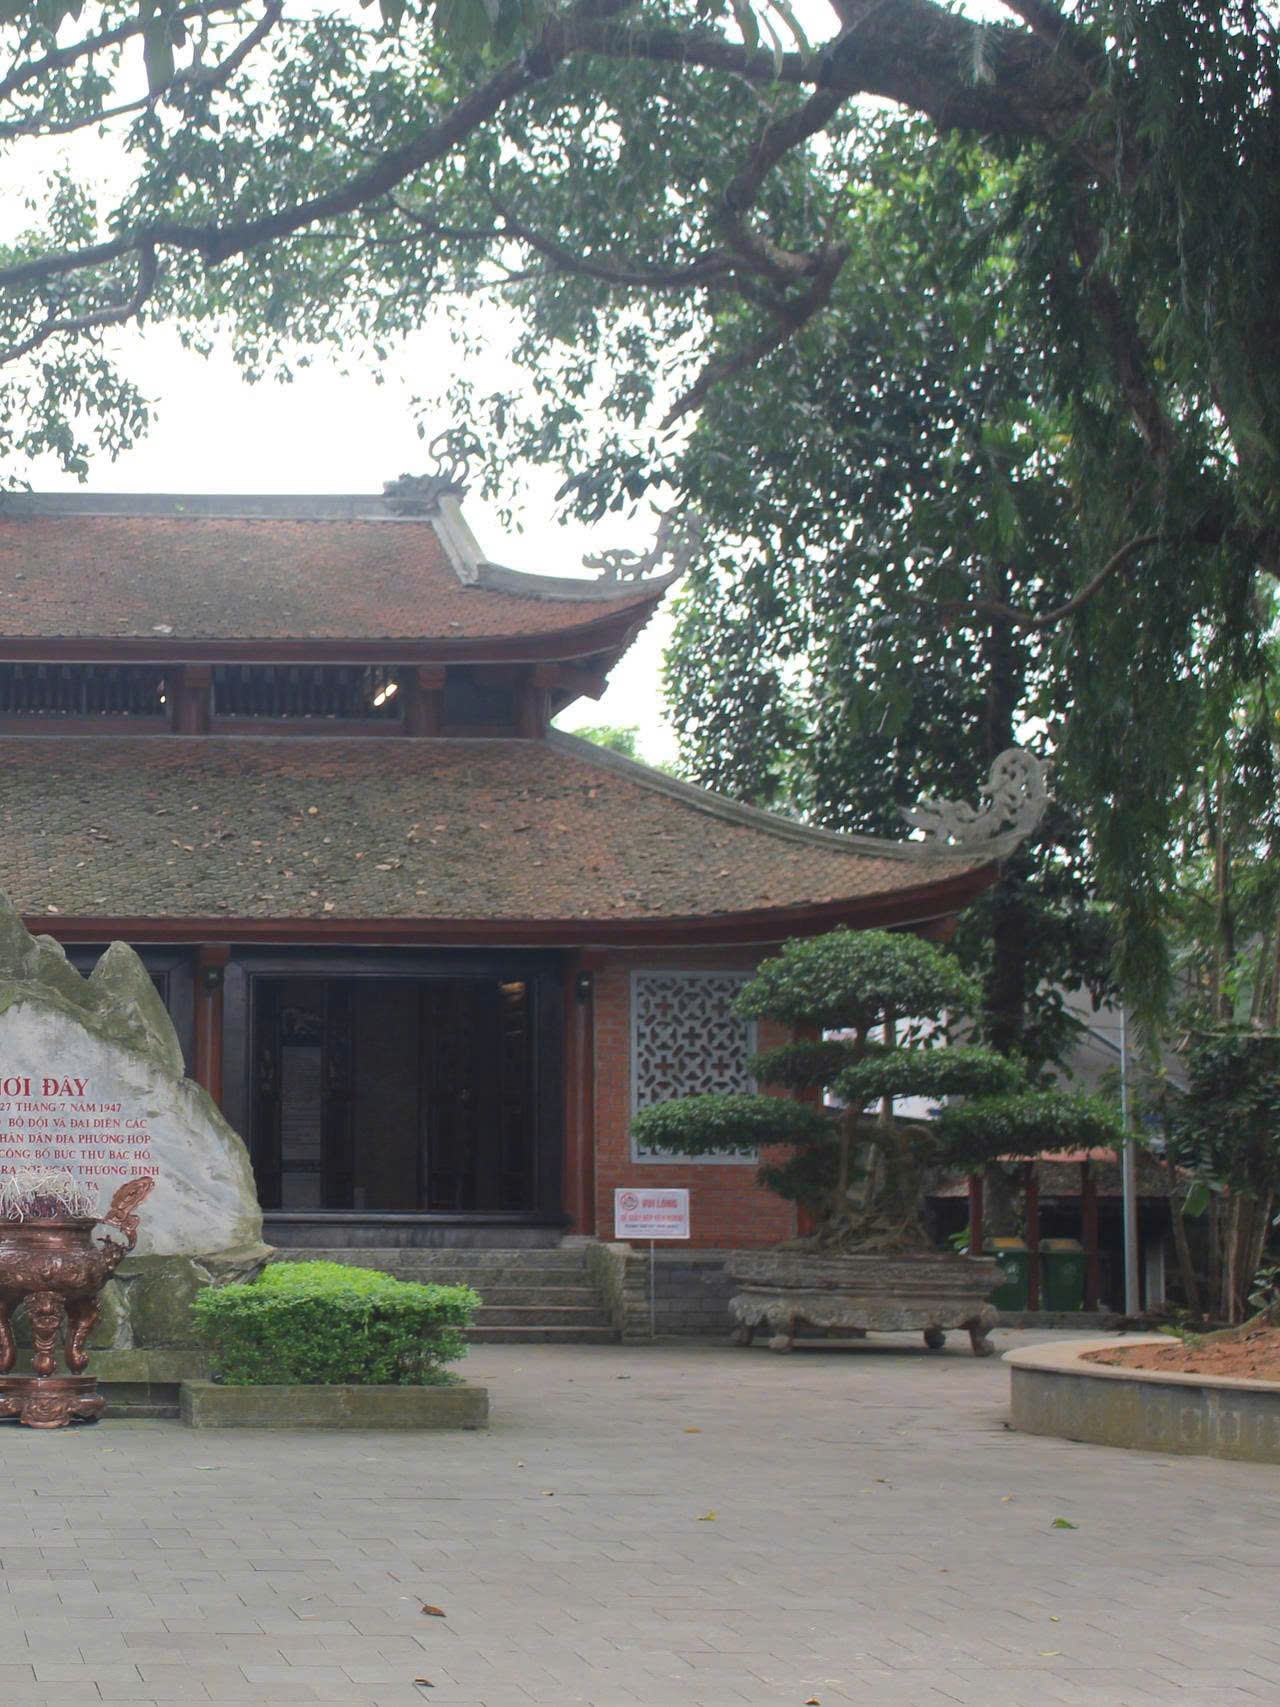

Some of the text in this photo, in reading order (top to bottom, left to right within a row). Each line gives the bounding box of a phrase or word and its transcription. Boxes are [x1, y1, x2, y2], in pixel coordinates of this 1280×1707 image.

[42, 1075, 90, 1097] ĐÂY
[0, 1102, 12, 1112] 27
[59, 1103, 66, 1113] 7
[99, 1103, 122, 1113] 1947
[1, 1165, 17, 1175] RA
[131, 1166, 160, 1176] BINH
